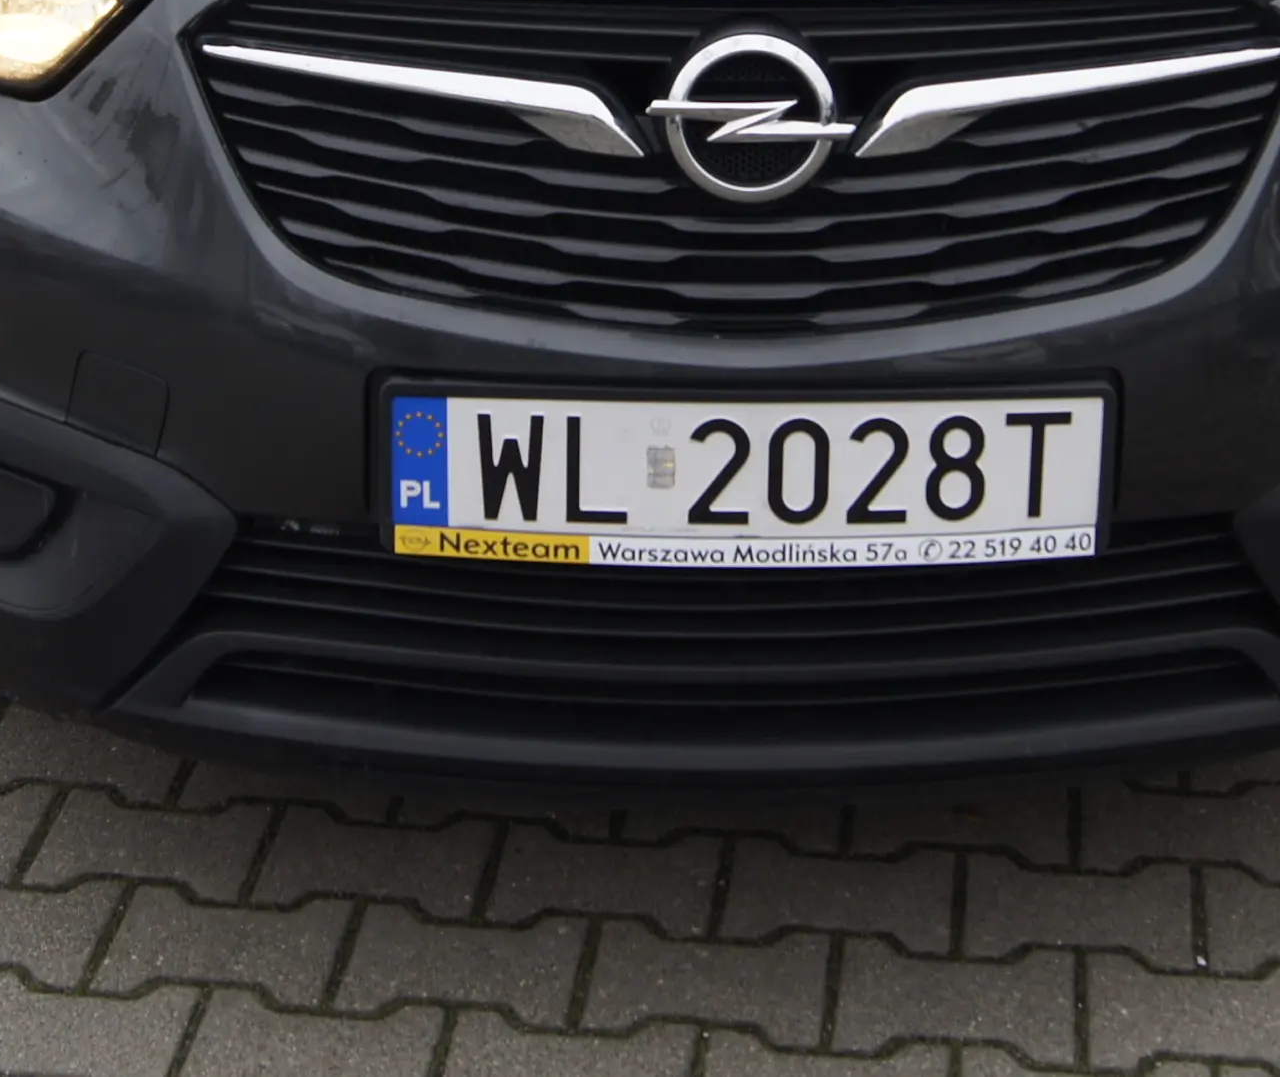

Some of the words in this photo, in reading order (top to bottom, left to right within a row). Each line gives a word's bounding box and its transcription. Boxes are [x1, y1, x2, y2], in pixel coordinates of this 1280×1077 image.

[477, 413, 628, 525] WL
[687, 411, 1072, 525] 2028T
[399, 479, 441, 509] PL
[439, 531, 581, 561] Nexteam
[598, 542, 726, 564] Warszawa
[732, 542, 858, 564] Modlińska
[866, 543, 908, 563] 57a
[948, 540, 976, 560] 22
[984, 537, 1023, 558] 519
[1029, 534, 1057, 554] 40
[1064, 532, 1092, 552] 40
